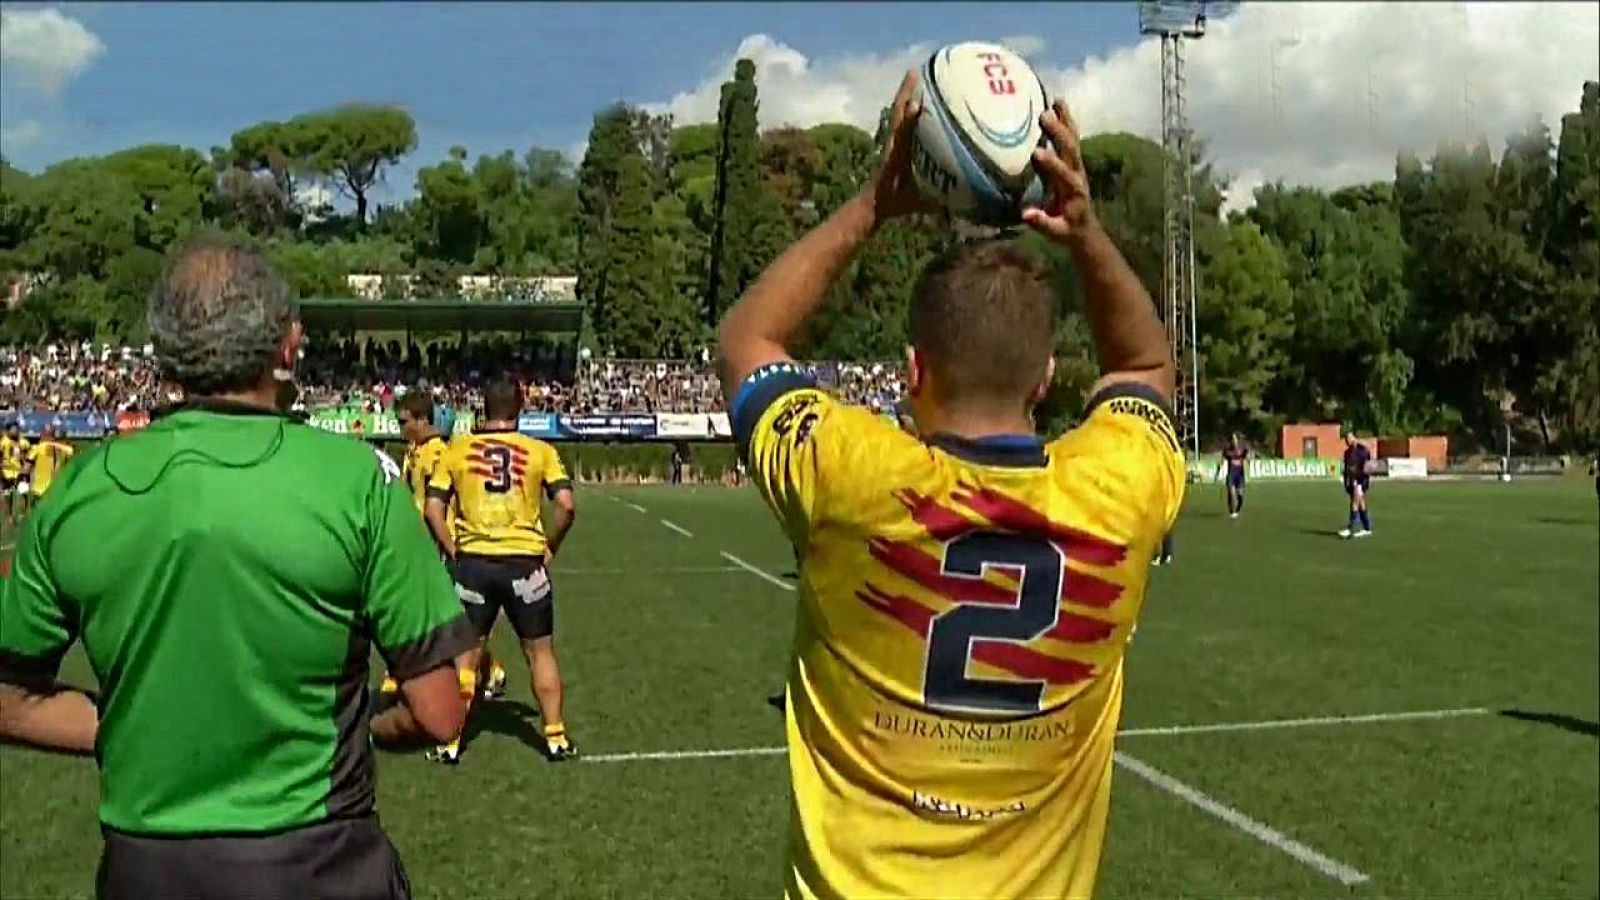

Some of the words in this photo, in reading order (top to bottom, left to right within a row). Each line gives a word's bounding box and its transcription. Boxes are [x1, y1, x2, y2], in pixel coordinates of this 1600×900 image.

[483, 447, 512, 493] 3
[1249, 459, 1326, 477] Heineken
[920, 528, 1066, 714] 2
[874, 711, 1071, 741] DURAN&DURAN
